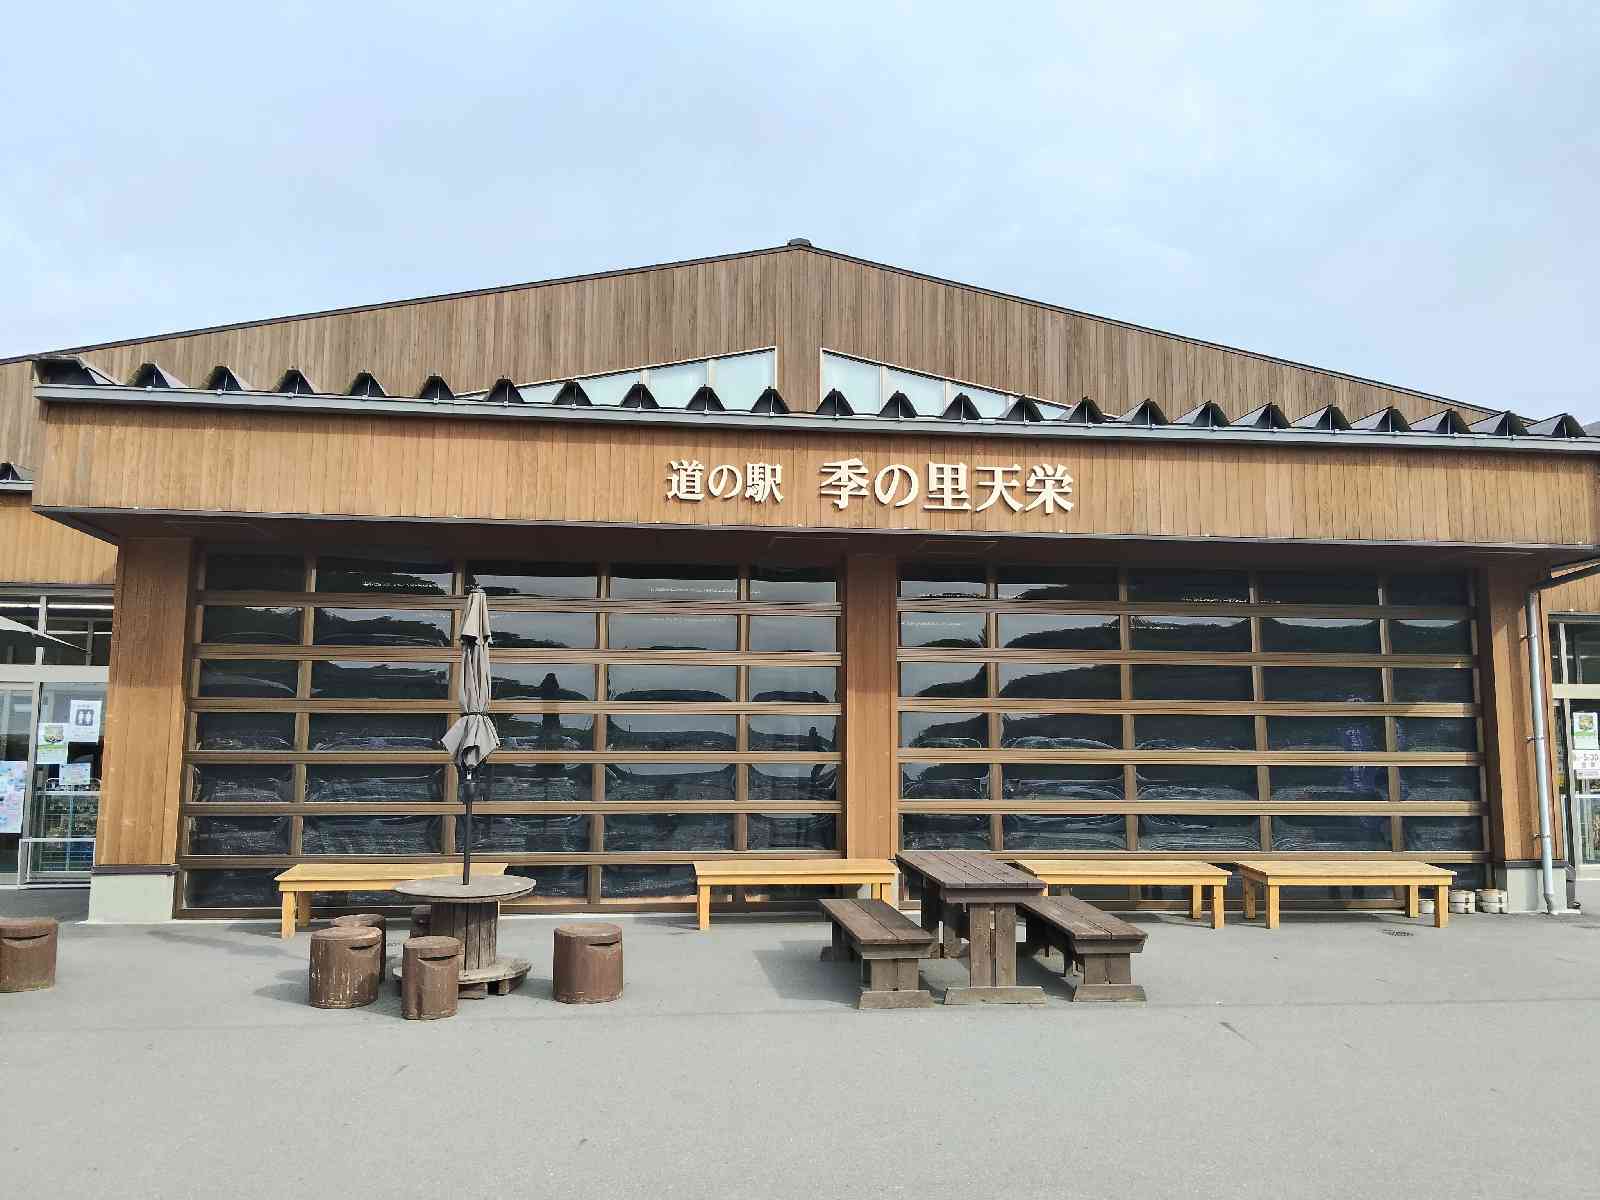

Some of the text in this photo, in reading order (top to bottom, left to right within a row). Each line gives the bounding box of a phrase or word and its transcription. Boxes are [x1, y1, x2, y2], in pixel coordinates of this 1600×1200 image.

[667, 458, 1074, 513] 道の駅 季の里天栄
